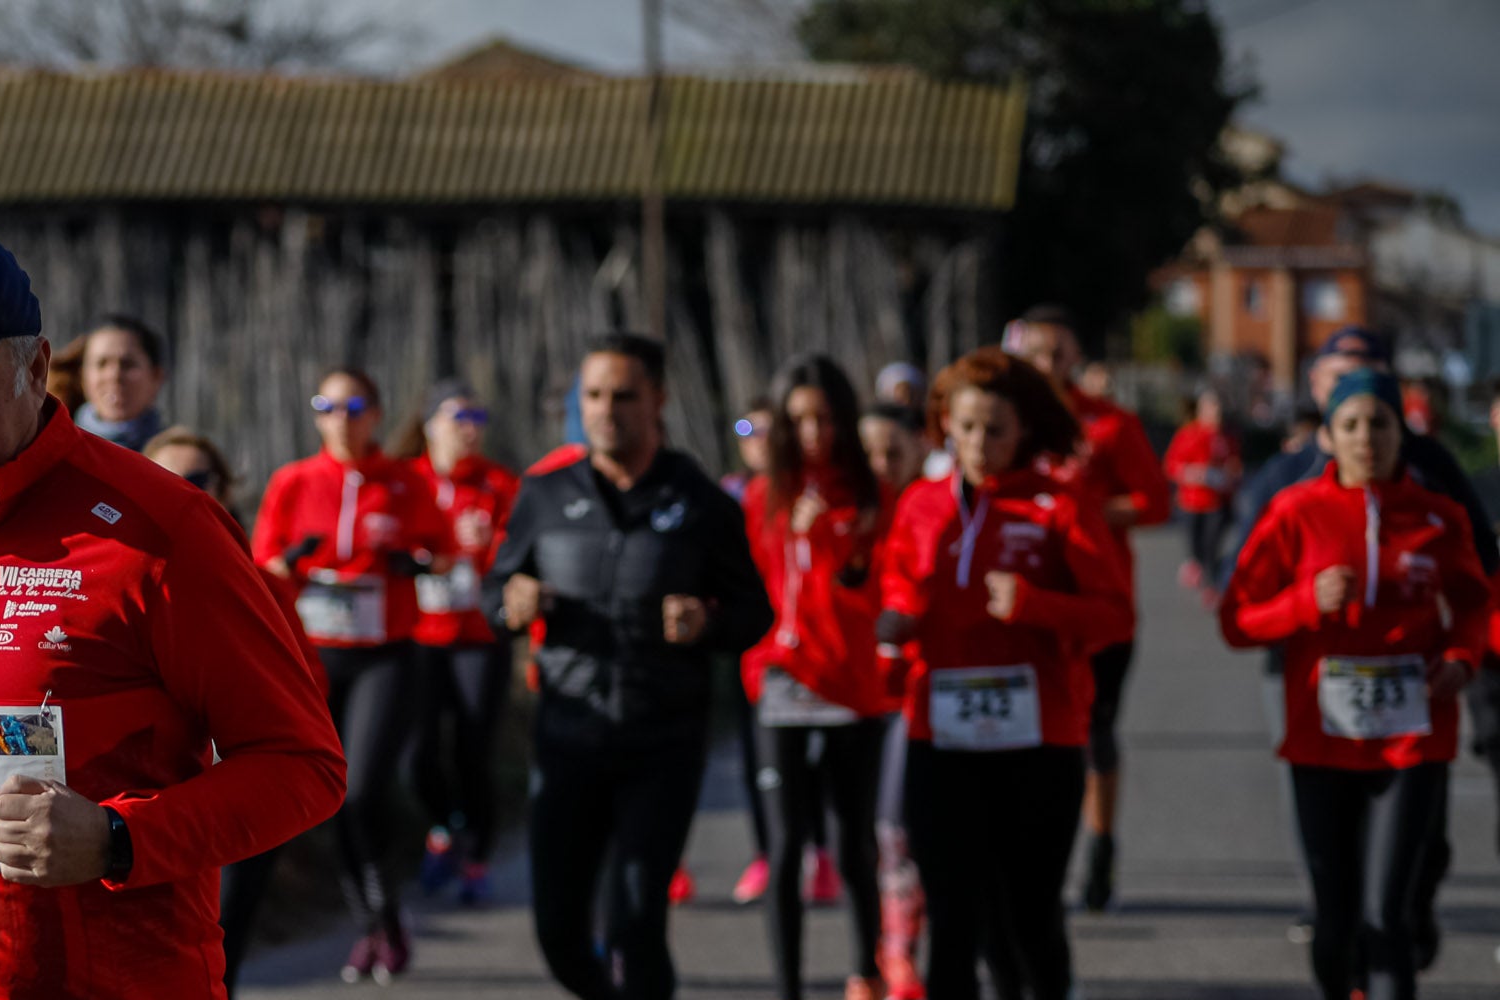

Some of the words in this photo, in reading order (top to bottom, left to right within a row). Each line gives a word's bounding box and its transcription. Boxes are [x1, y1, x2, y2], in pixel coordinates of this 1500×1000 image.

[0, 565, 19, 586] VII
[19, 567, 82, 580] CARRERA
[17, 577, 81, 590] POPULAR
[11, 585, 22, 596] de
[26, 586, 40, 596] los
[19, 601, 57, 612] olimpo
